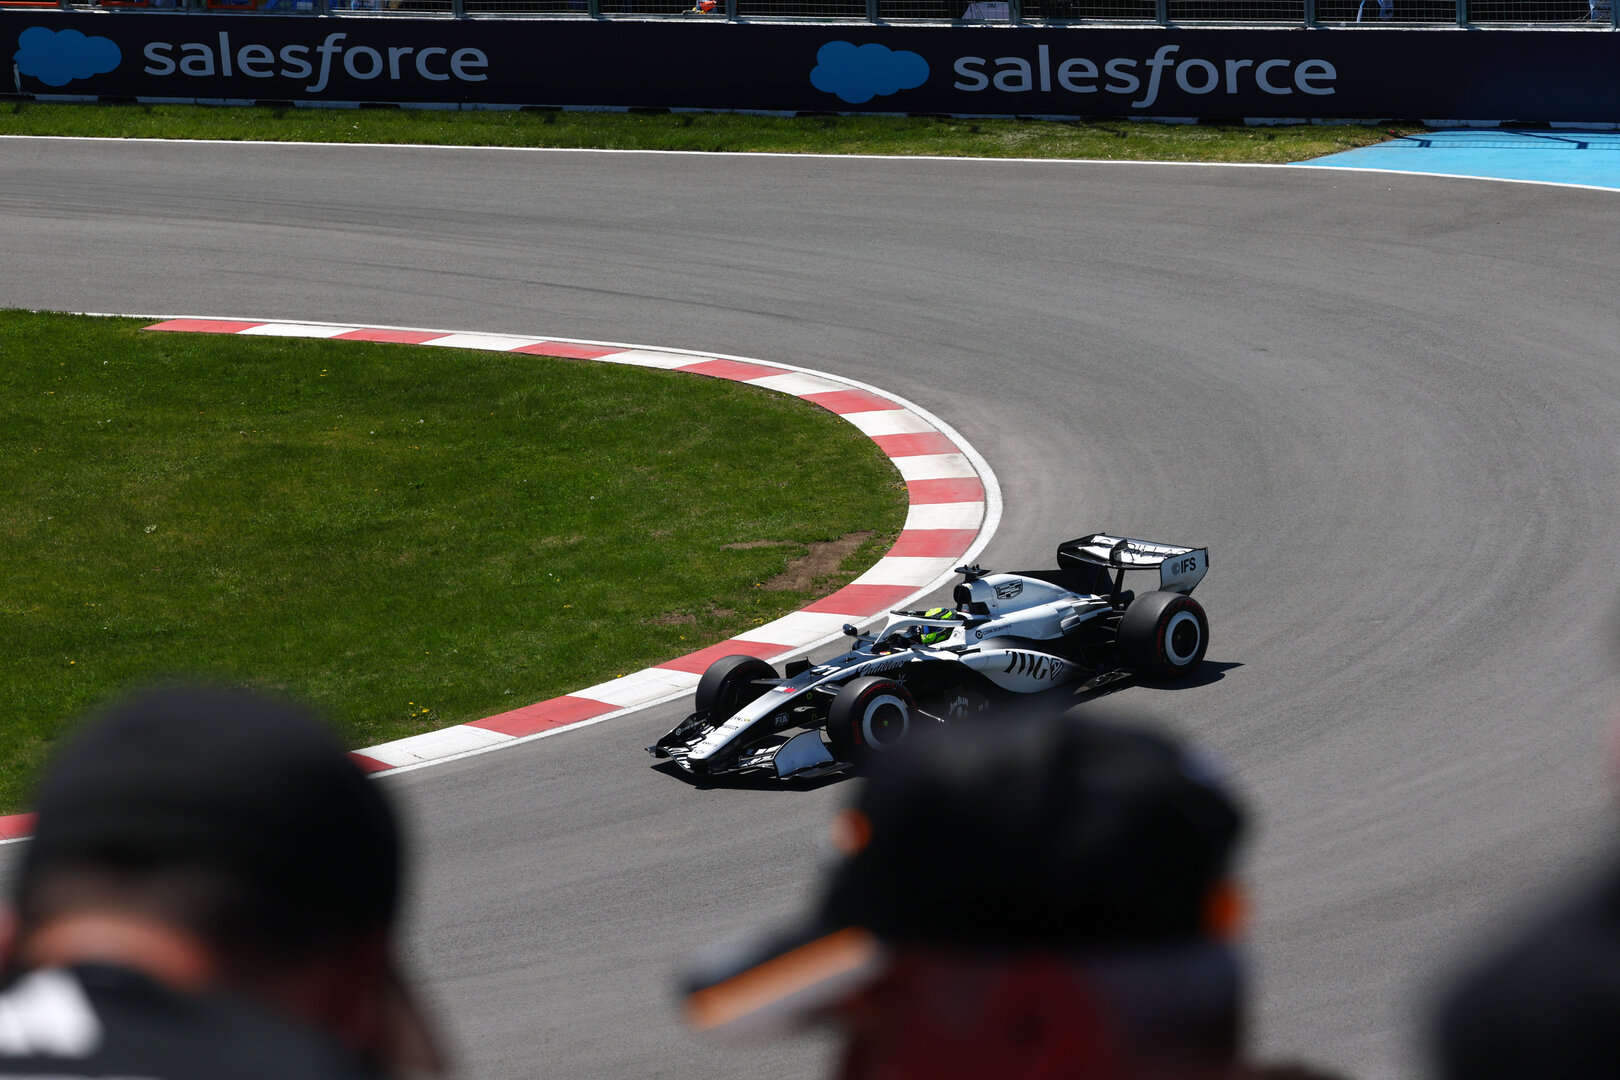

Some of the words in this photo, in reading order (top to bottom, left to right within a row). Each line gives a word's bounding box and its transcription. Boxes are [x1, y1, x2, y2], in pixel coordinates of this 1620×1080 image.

[143, 31, 489, 93] salesforce
[952, 44, 1337, 108] salesforce
[1180, 556, 1197, 574] IFS
[856, 660, 905, 677] Cadillac
[775, 714, 788, 725] FIA
